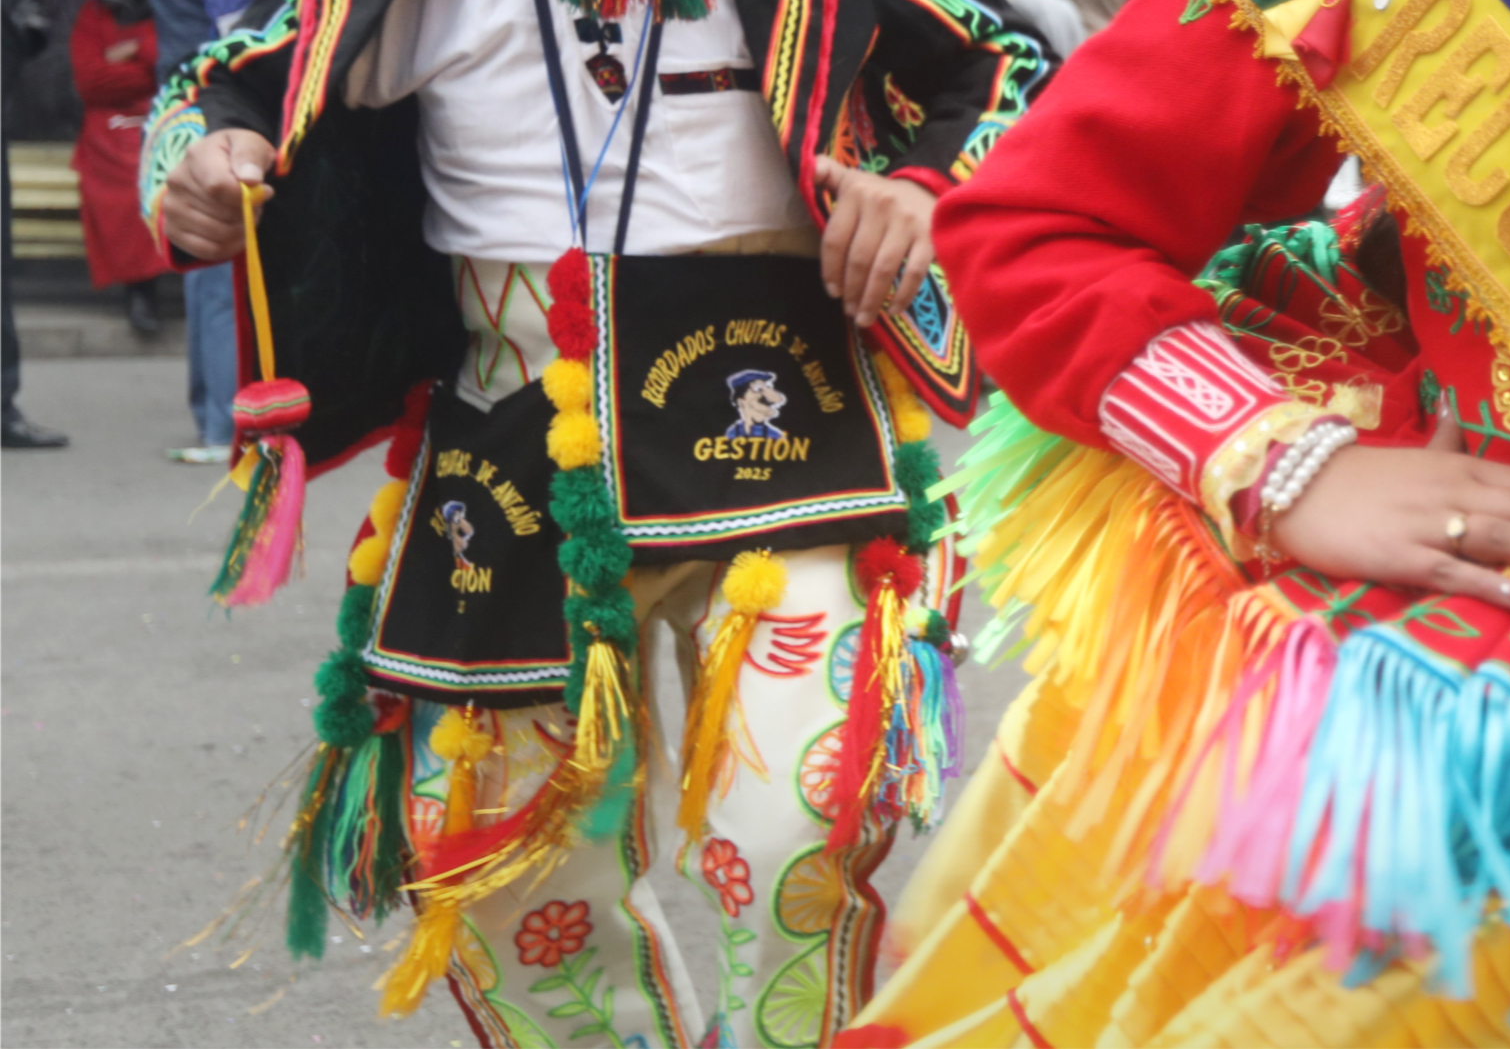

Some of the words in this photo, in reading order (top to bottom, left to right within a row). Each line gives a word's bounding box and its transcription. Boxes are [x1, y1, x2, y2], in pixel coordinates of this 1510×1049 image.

[641, 325, 716, 409] RECORDADOS
[725, 319, 787, 348] CHUTAS
[734, 467, 773, 481] 2025
[491, 479, 543, 537] ANTAÑO
